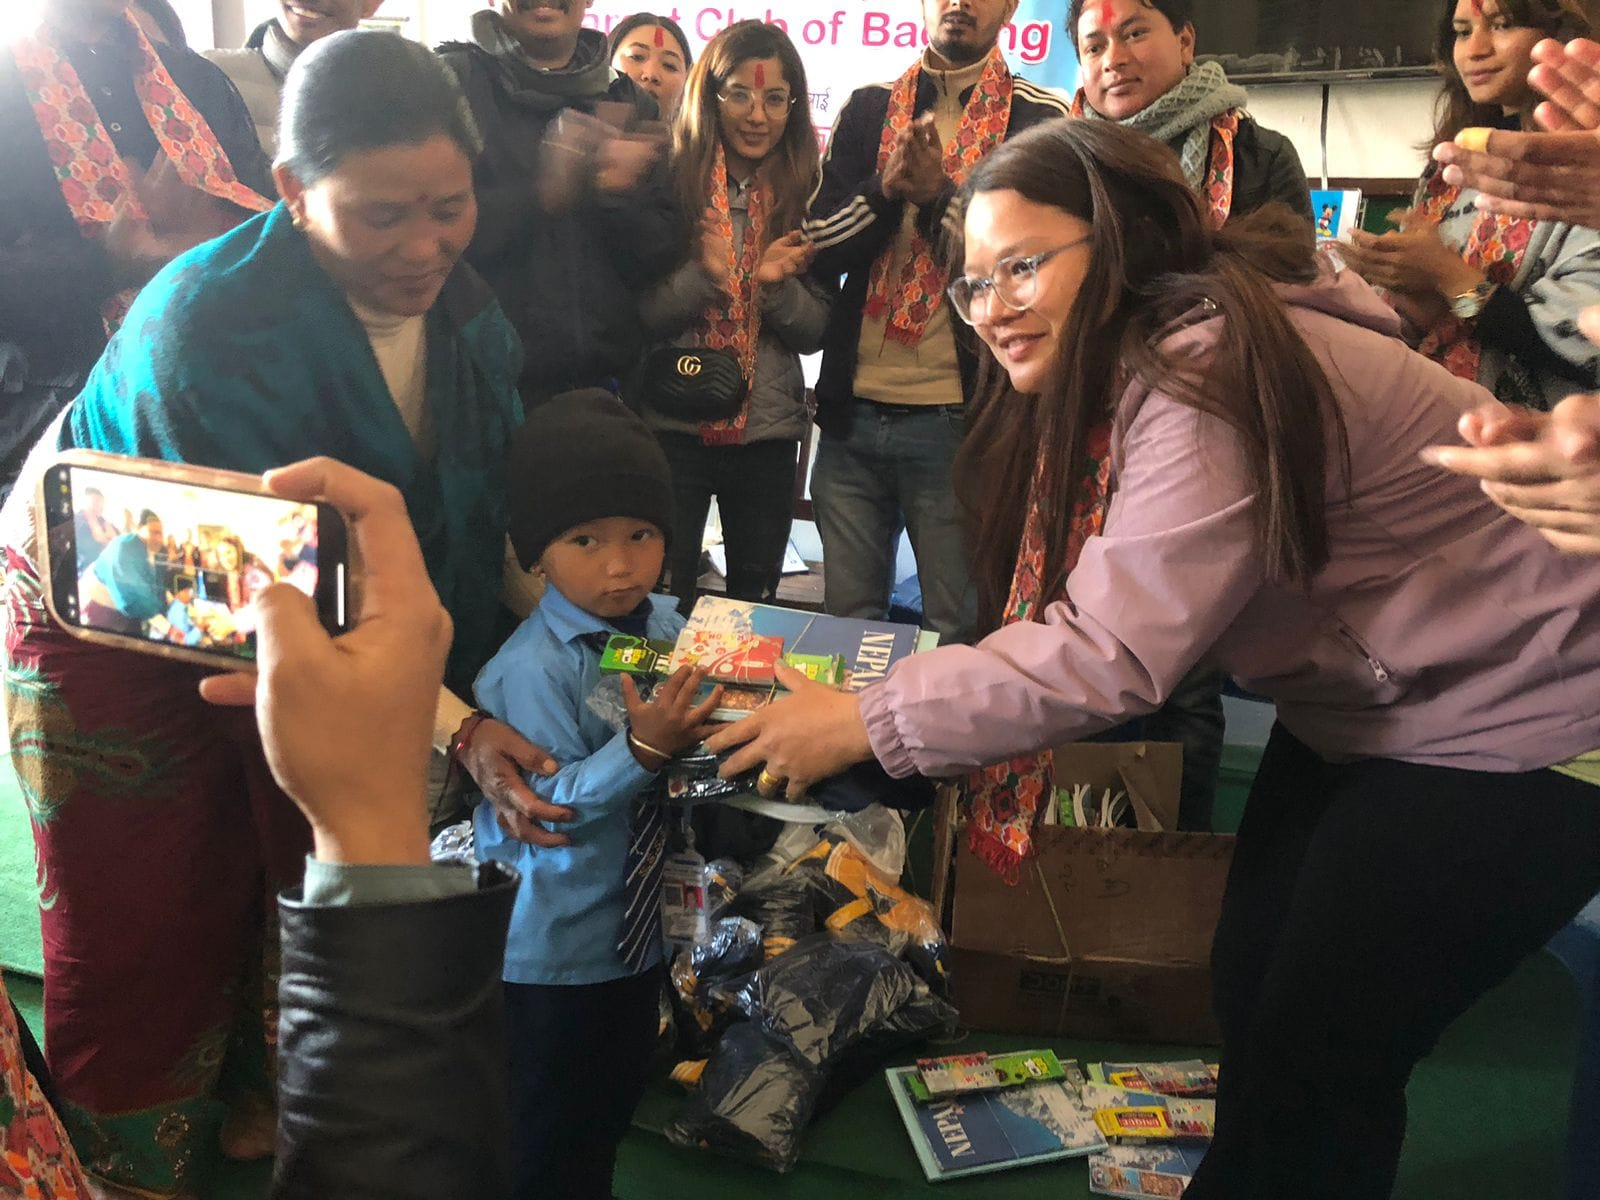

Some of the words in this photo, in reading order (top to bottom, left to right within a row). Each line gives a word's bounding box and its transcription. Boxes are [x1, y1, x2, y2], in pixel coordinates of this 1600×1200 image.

[695, 8, 788, 41] Clb
[802, 11, 846, 45] of
[861, 11, 1050, 62] Bang
